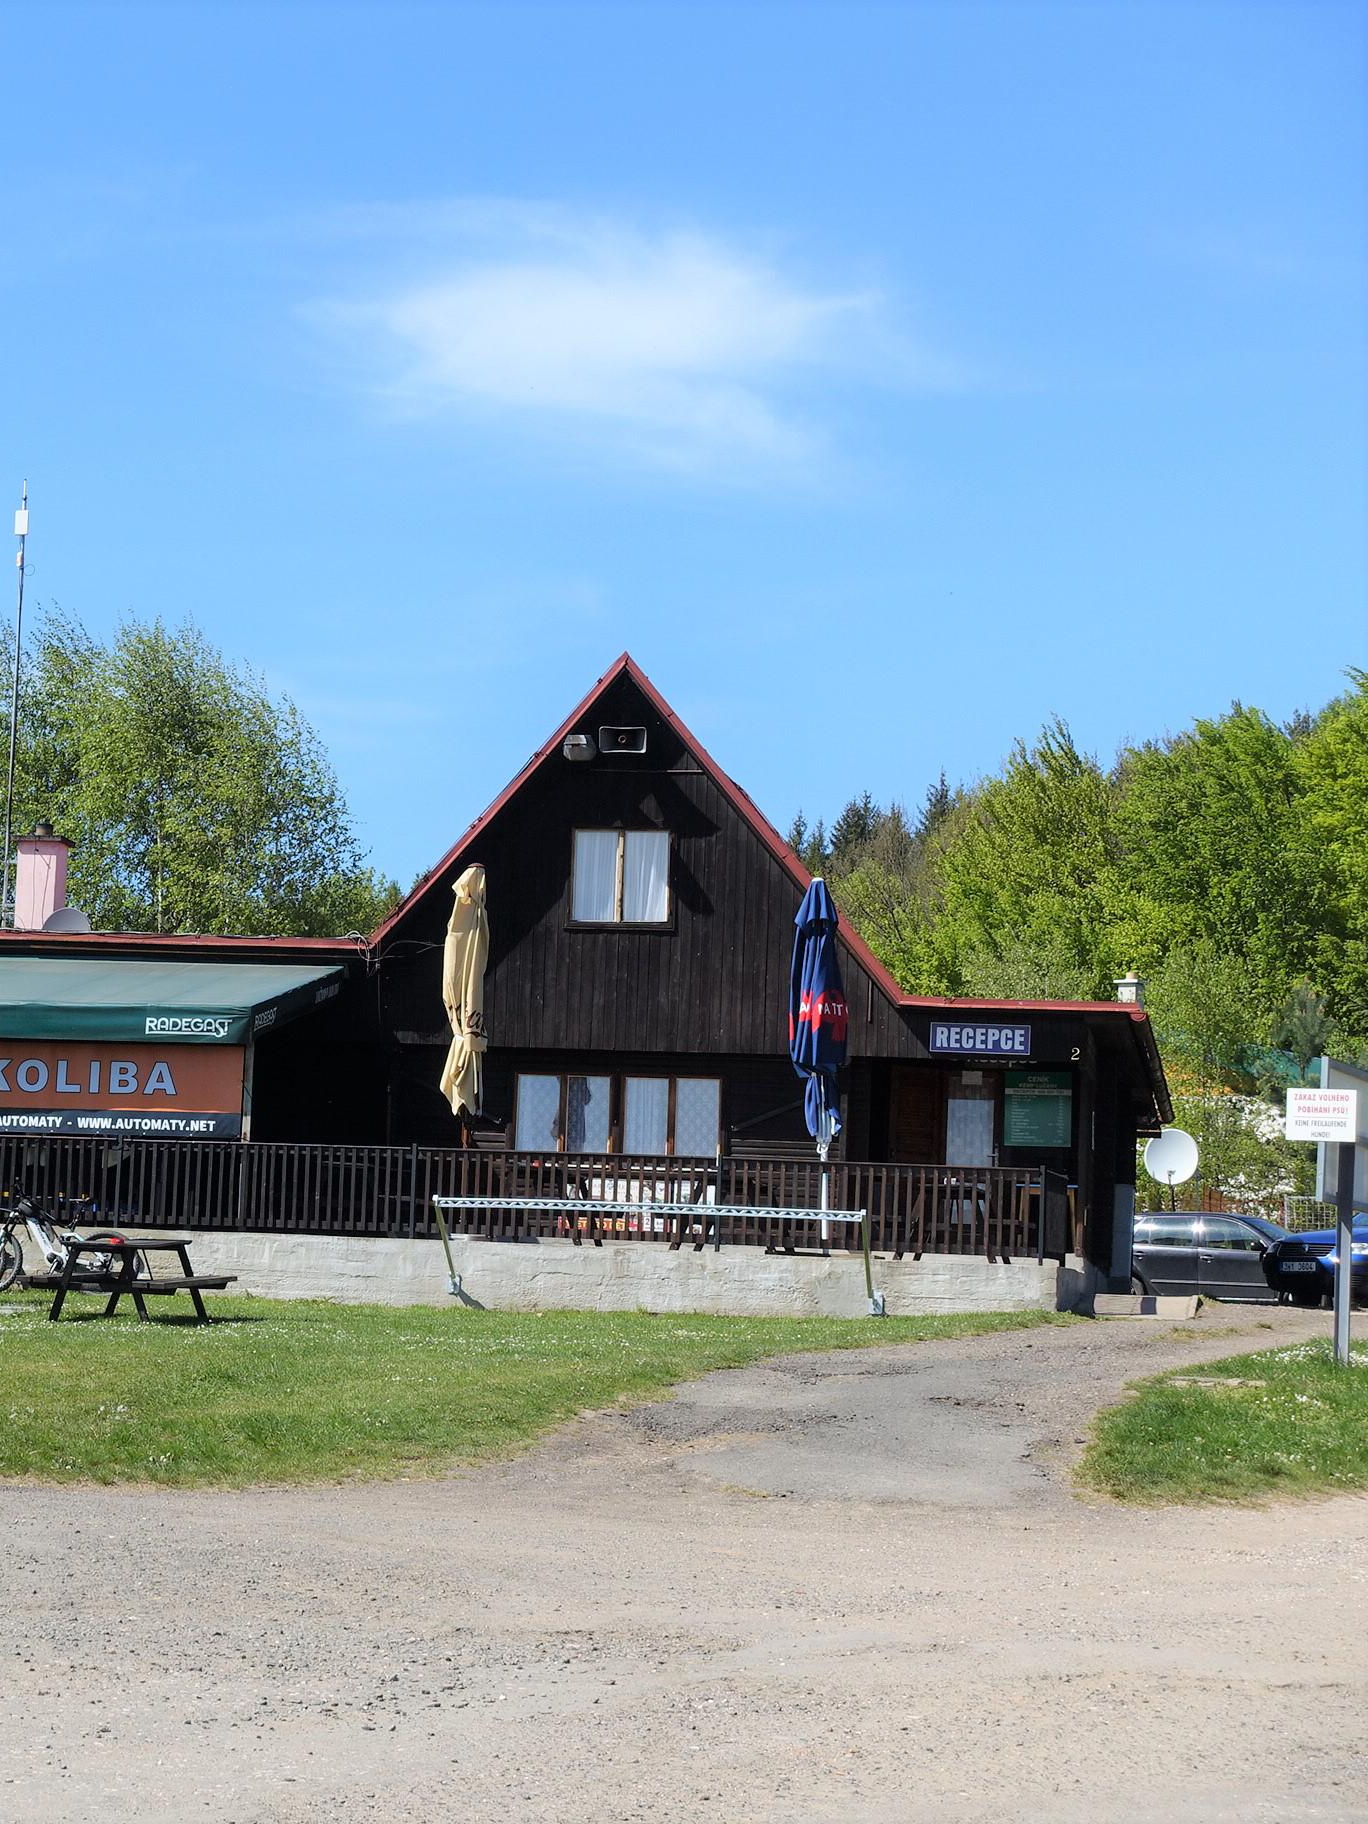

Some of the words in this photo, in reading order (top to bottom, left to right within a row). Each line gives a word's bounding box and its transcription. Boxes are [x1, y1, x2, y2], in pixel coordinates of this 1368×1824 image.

[145, 1017, 232, 1038] RADEGAST
[935, 1026, 1025, 1050] RECEPCE
[1070, 1047, 1080, 1061] 2
[77, 1116, 216, 1132] WWW.AUTOMATY.NET
